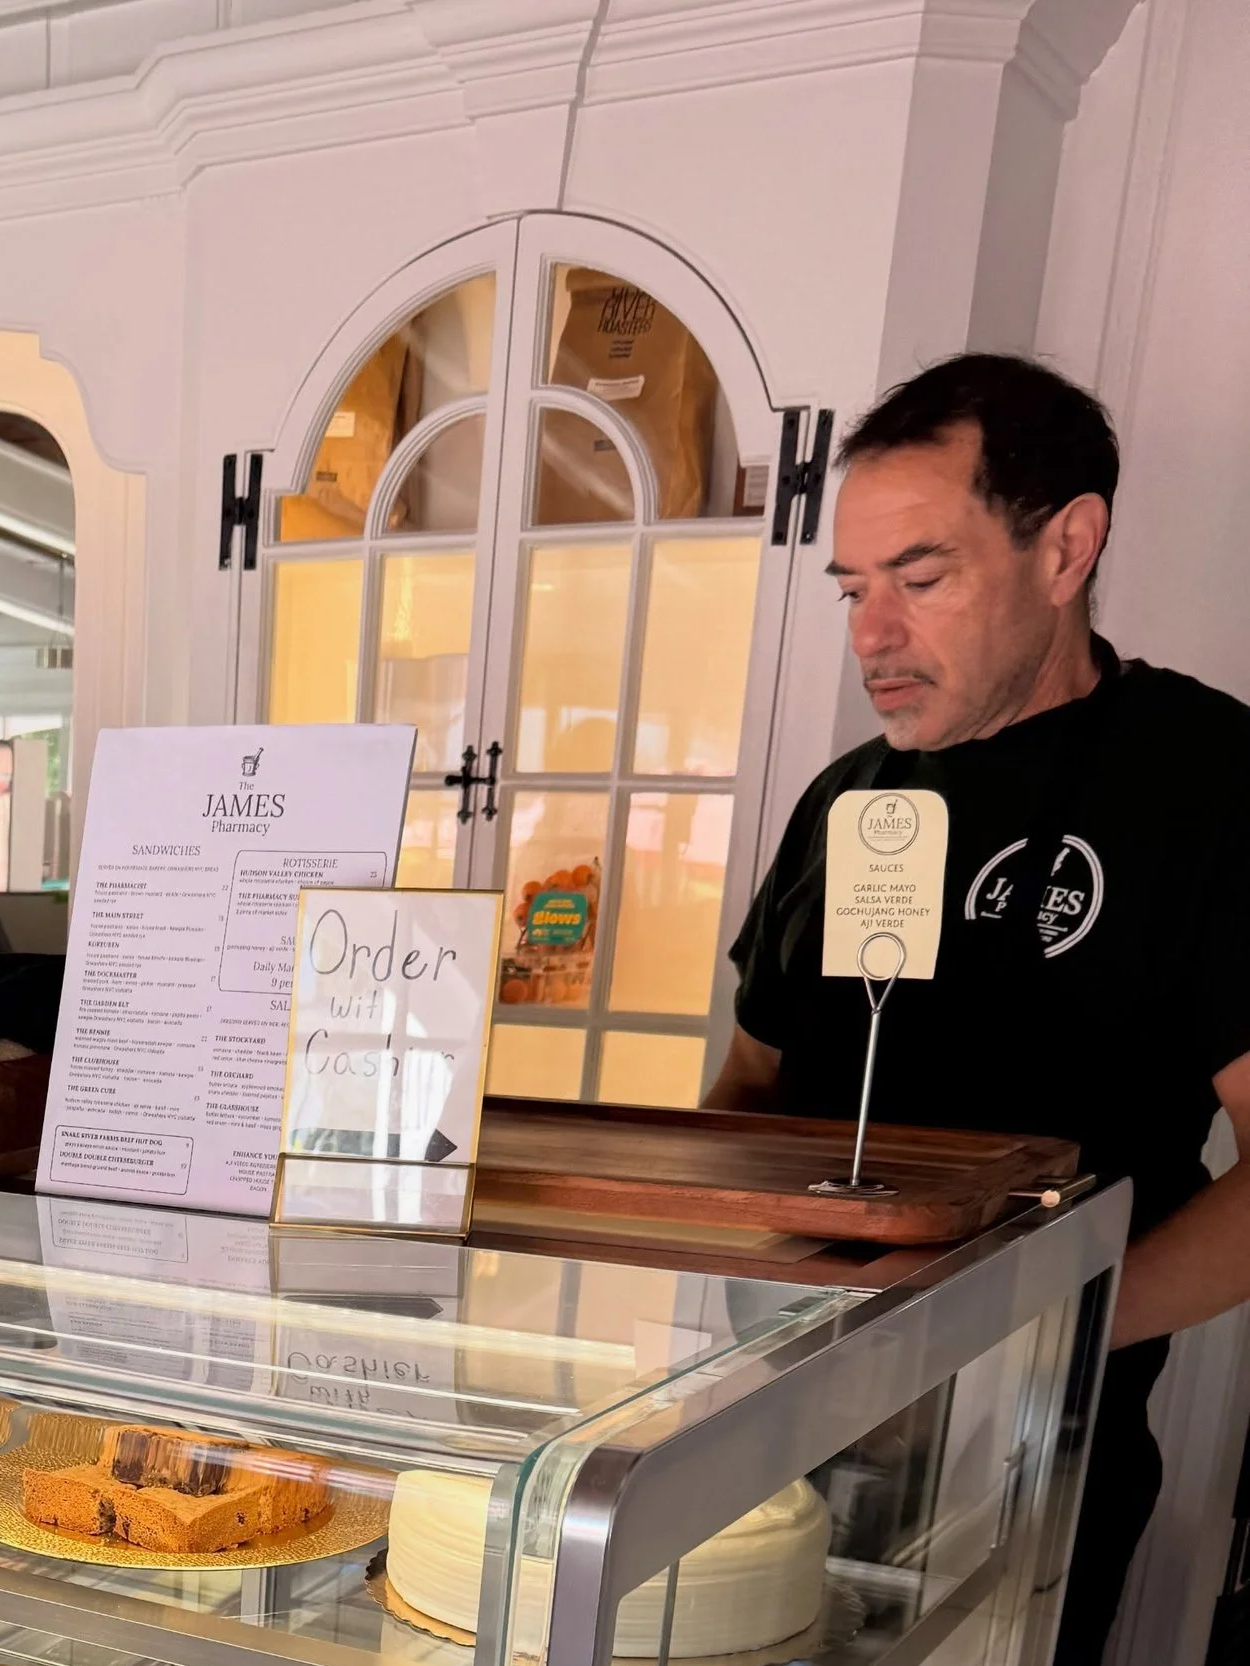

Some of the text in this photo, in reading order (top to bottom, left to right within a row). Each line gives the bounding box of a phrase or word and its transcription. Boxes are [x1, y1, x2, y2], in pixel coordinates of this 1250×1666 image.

[239, 781, 254, 791] The
[202, 793, 285, 818] JAMES
[211, 820, 270, 837] Pharmacy
[867, 817, 912, 830] JAMES
[132, 844, 201, 856] SANDWICHES
[283, 858, 338, 869] ROTISSERIE
[869, 864, 904, 873] SAUCES
[853, 884, 916, 893] GARLIC MAYO
[855, 896, 913, 904] SALSA VERDE
[836, 907, 931, 917] GOCHUJANG HONEY
[860, 919, 905, 930] AJI VERDE
[310, 909, 456, 982] Order
[253, 961, 276, 975] Daily
[97, 971, 137, 979] DOCKMASTER
[271, 978, 278, 988] 9
[270, 1000, 292, 1011] SAL
[330, 990, 380, 1020] wit
[229, 1036, 266, 1044] STOCKYARD
[84, 1057, 119, 1066] CLUBHOUSE
[80, 1085, 100, 1093] GREEN
[219, 1104, 259, 1112] GLASSHOUSE
[61, 1131, 80, 1139] SNAKE
[81, 1132, 98, 1140] RIVER
[99, 1134, 118, 1142] FARMS
[60, 1151, 154, 1166] DOUBLE DOUBLE CHEESEBURGER
[233, 1151, 263, 1159] ENHANCE
